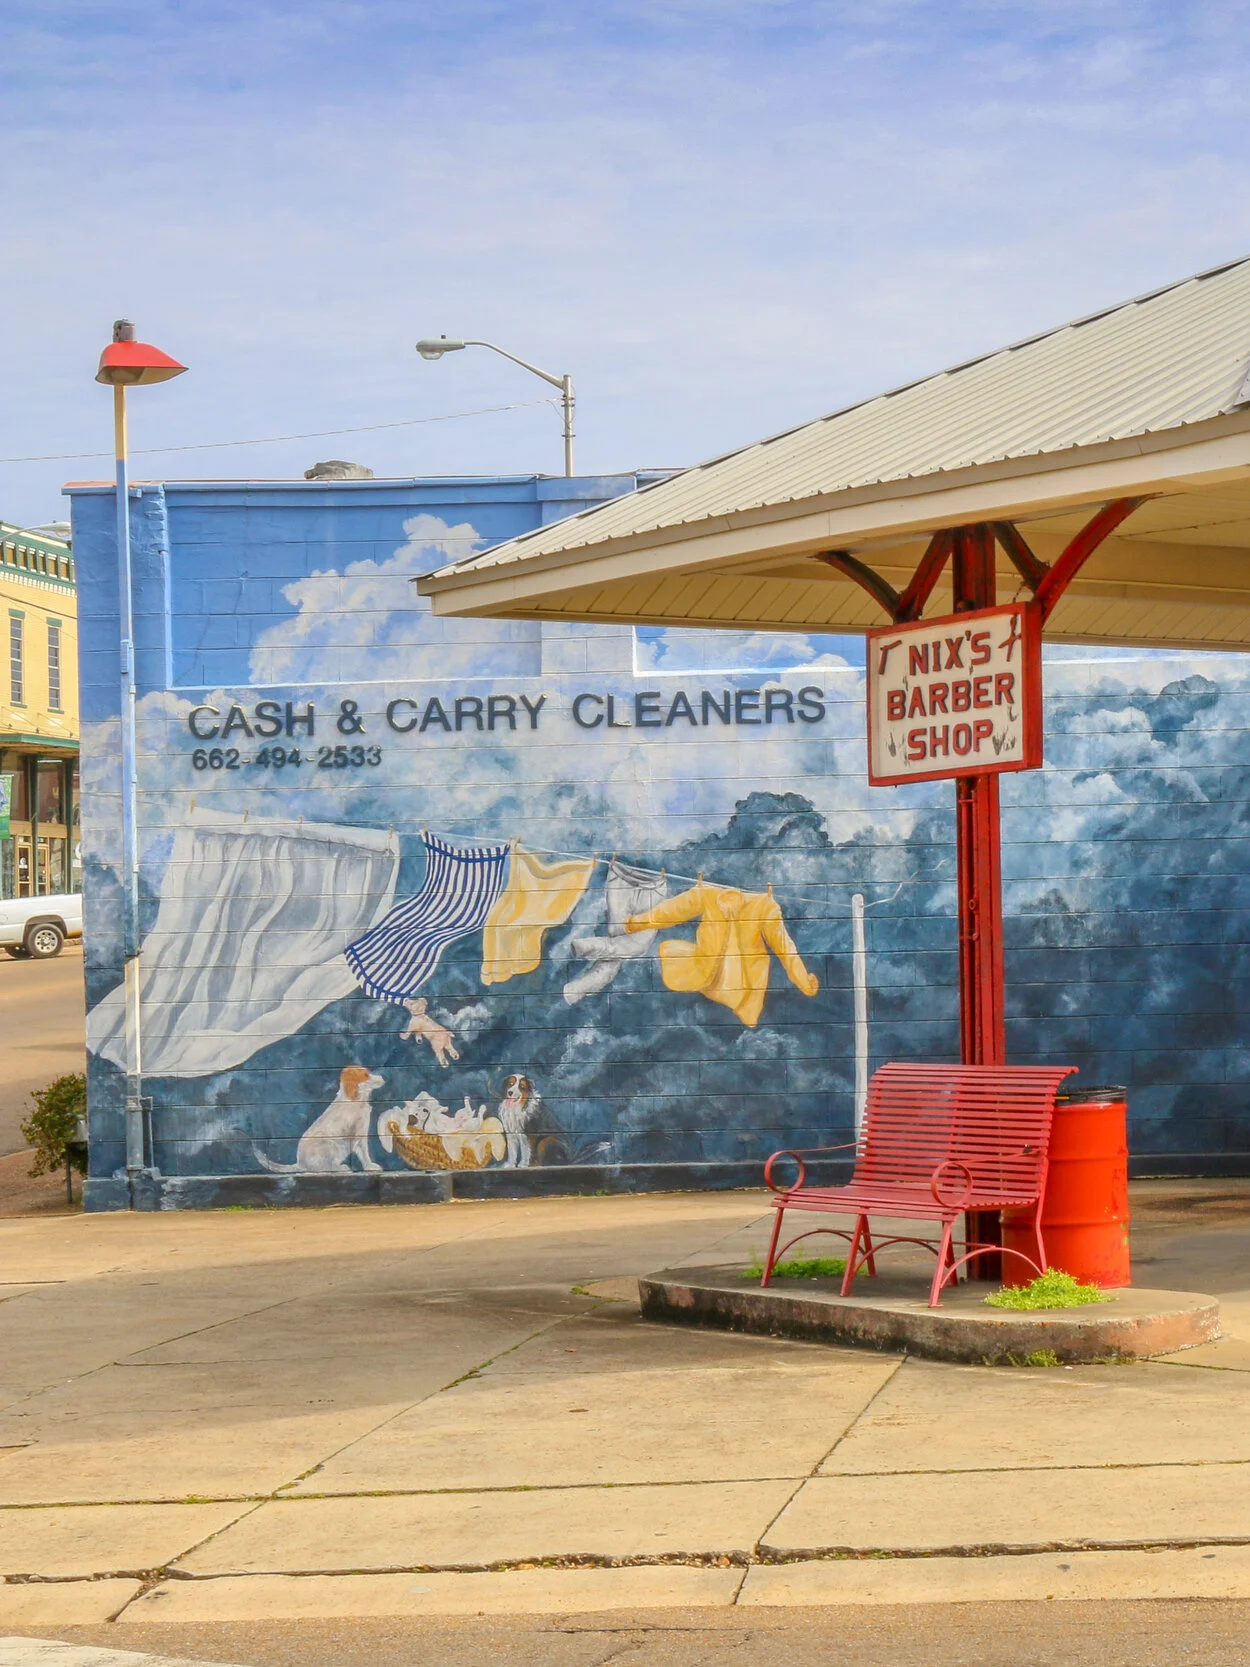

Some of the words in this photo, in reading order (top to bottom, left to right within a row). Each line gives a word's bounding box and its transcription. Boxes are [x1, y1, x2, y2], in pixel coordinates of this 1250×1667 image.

[909, 630, 991, 676] NIX'S
[188, 701, 315, 740] CASH
[336, 698, 368, 734] &
[386, 694, 548, 734] CARRY
[572, 687, 827, 728] CLEANERS
[887, 672, 1015, 721] BARBER
[191, 744, 383, 771] 662-494-2533
[907, 719, 994, 761] SHOP
